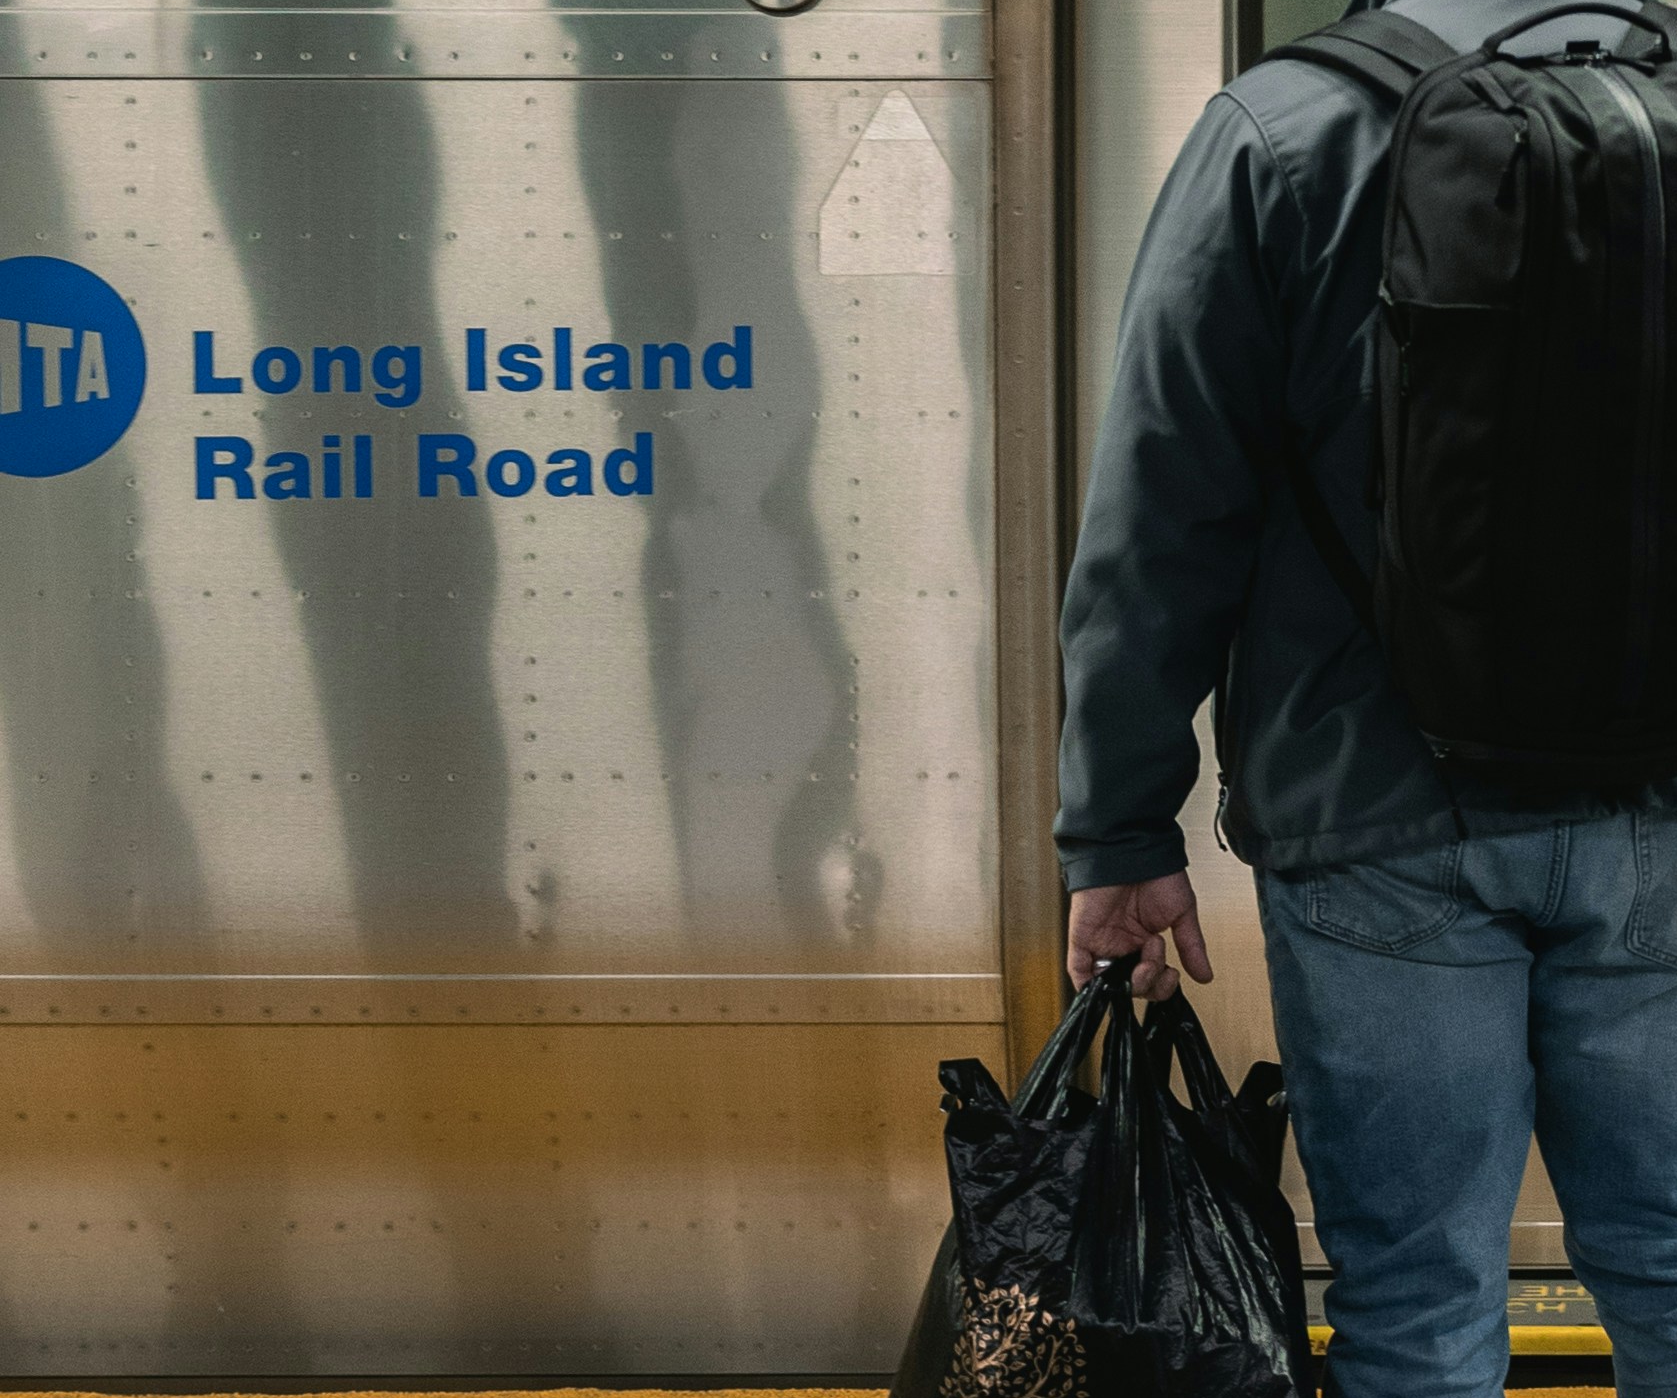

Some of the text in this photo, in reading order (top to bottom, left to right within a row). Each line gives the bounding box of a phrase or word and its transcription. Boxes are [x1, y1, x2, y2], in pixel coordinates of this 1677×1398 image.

[191, 325, 754, 408] Long Island
[193, 432, 655, 501] Rail Road
